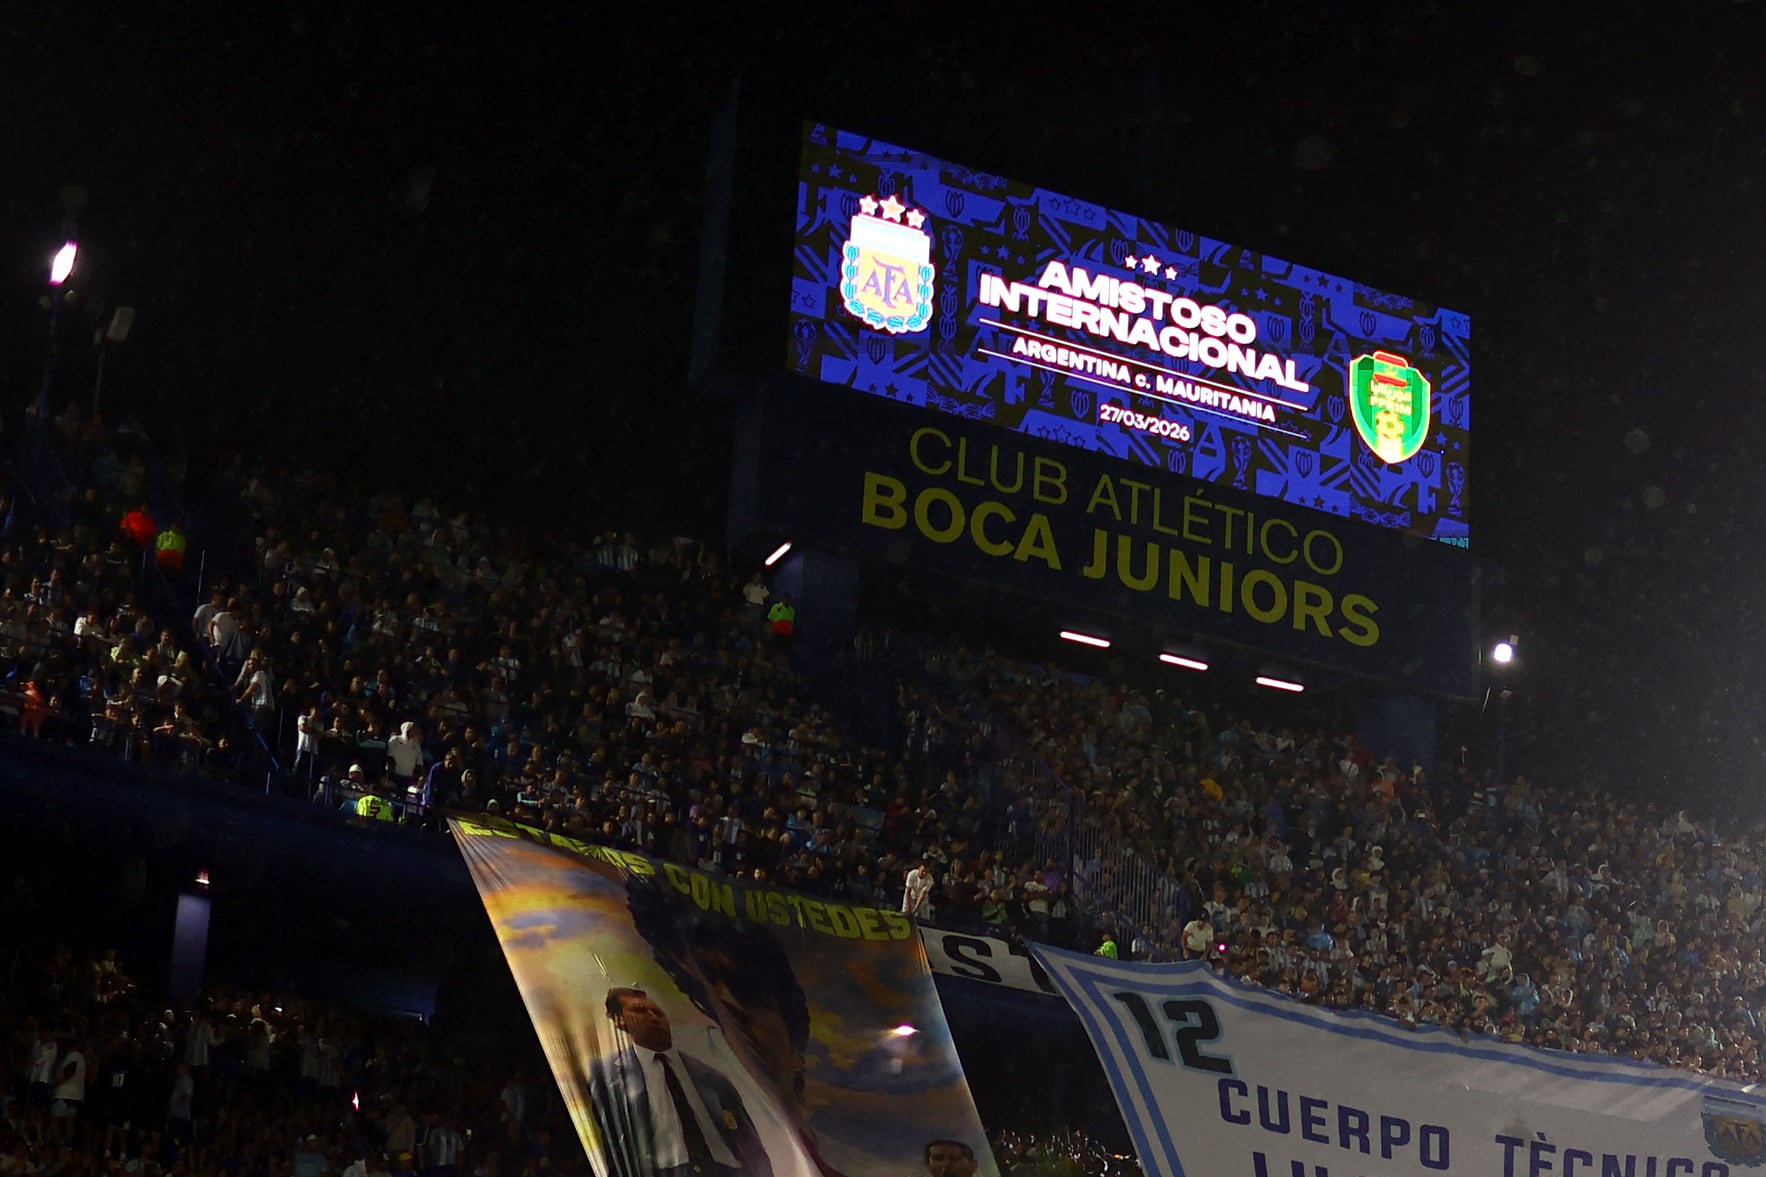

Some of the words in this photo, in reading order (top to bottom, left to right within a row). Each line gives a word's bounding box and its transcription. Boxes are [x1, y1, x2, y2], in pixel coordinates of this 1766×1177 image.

[979, 273, 1310, 392] INTERNACIONAL
[1038, 260, 1257, 345] AMISTOSO
[1013, 337, 1131, 383] ARGENTINA
[1135, 373, 1151, 389] c.
[1156, 375, 1276, 422] MAURITANIA
[1100, 404, 1191, 441] 27/03/2026
[909, 425, 1070, 505] CLUB
[1086, 473, 1345, 577] ATLÉTICO
[861, 471, 1063, 571] BOCA
[1083, 527, 1382, 648] JUNIORS
[456, 816, 656, 876] ESTAS
[664, 863, 736, 917] CON
[745, 889, 912, 941] USTEDES
[1113, 990, 1235, 1075] 12
[1218, 1078, 1450, 1171] CUERPO
